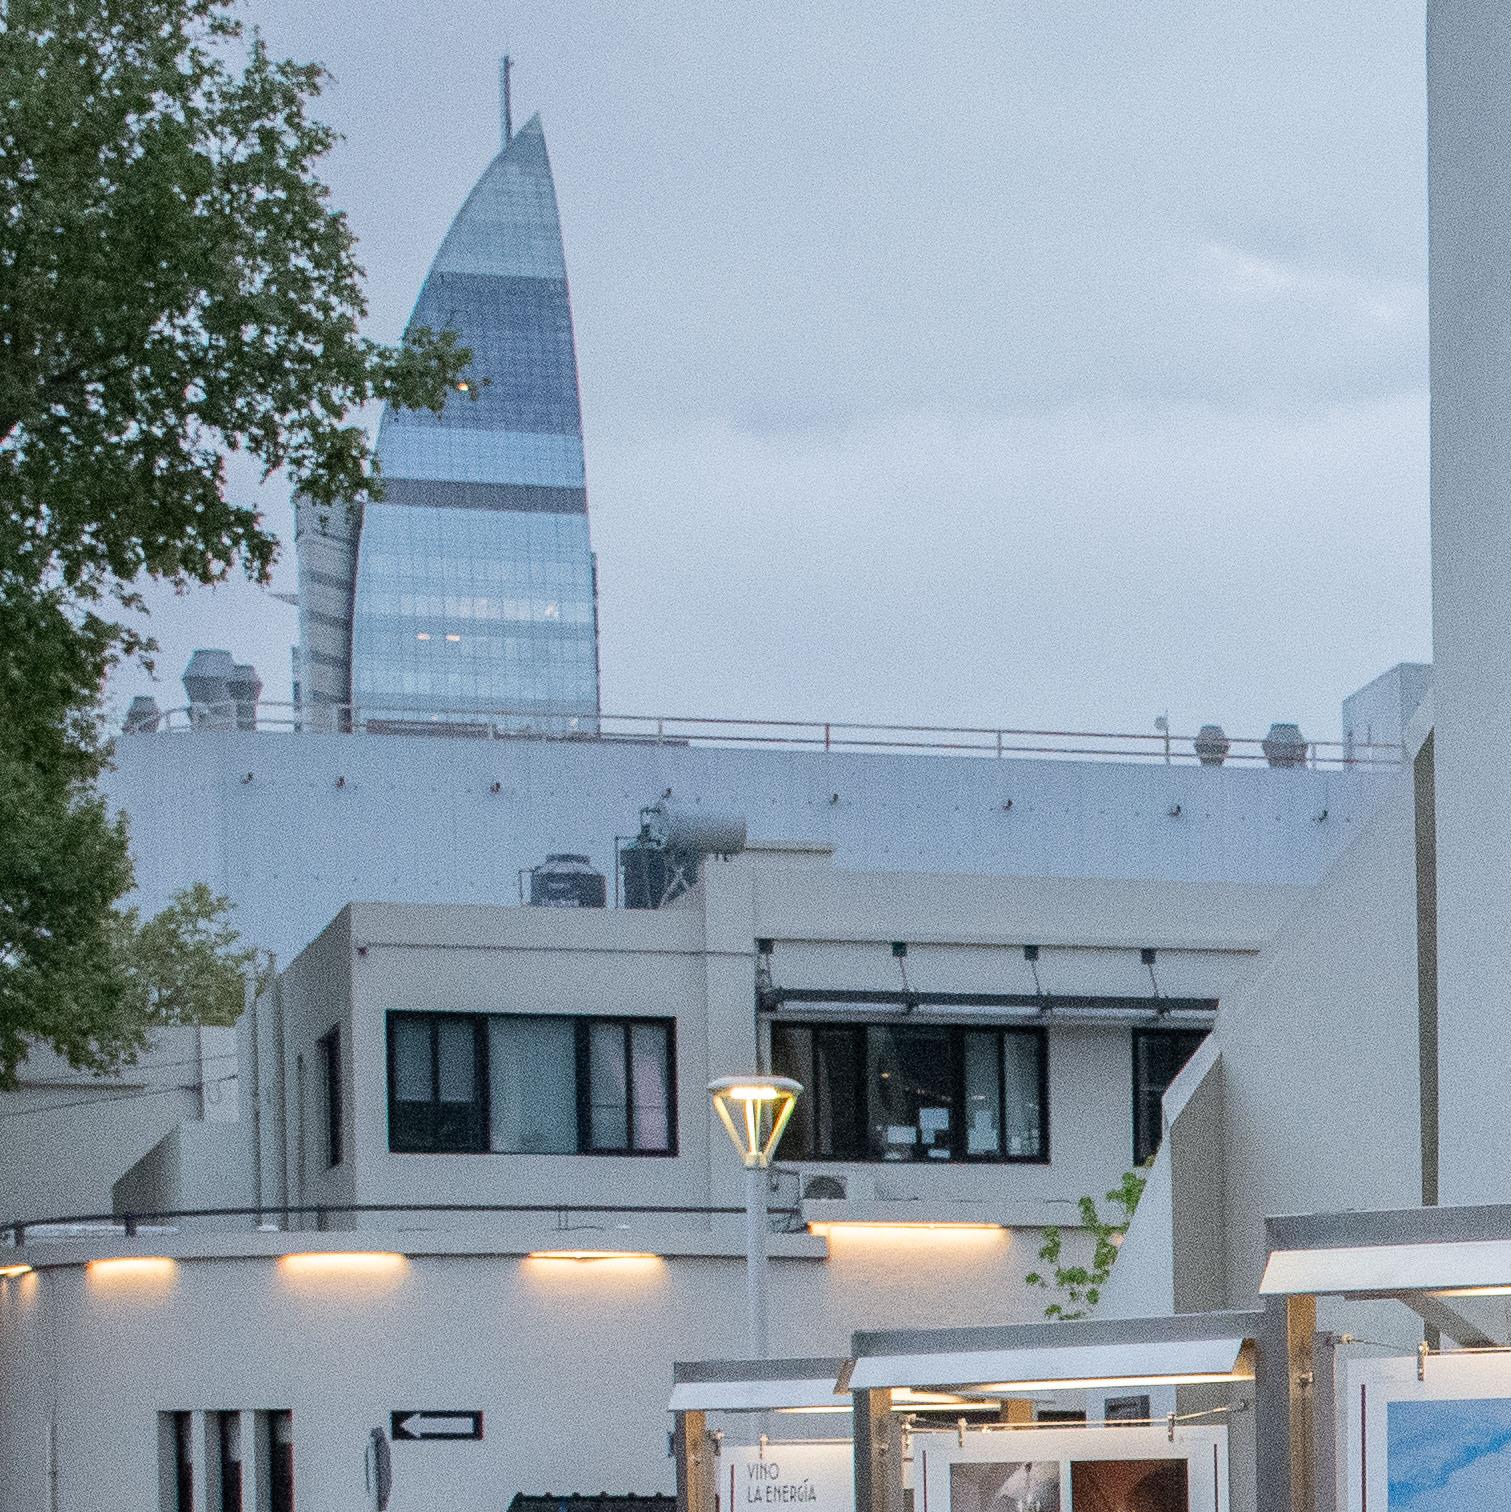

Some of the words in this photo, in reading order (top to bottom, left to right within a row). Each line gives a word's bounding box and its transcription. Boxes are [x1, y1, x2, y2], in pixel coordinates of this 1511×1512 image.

[746, 1462, 780, 1481] VINO
[747, 1485, 763, 1504] LA
[765, 1478, 817, 1503] ENERGÍA
